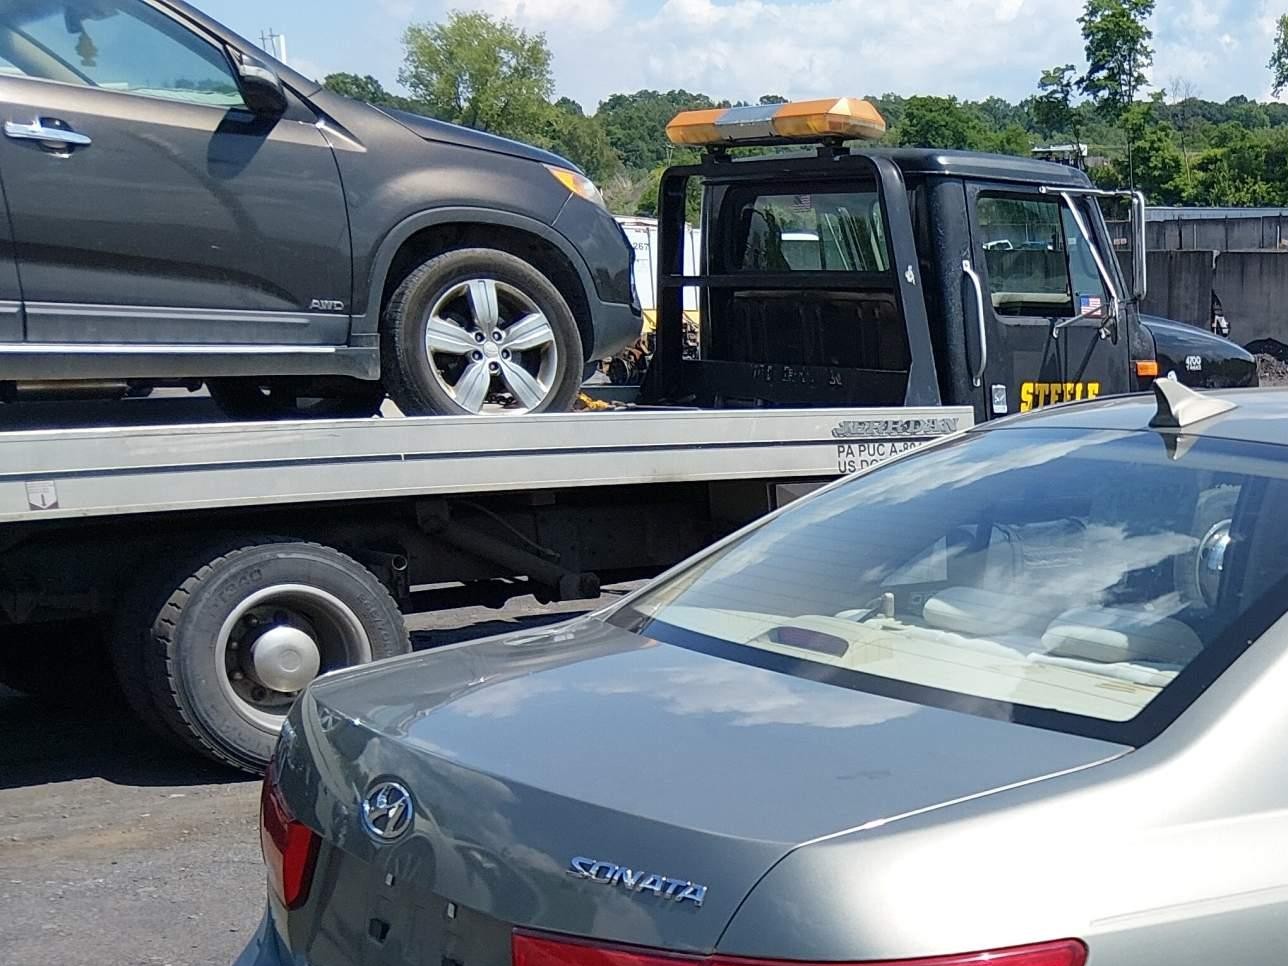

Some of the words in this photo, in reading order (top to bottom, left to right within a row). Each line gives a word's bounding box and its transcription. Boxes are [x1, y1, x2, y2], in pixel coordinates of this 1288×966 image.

[309, 299, 345, 310] AWD
[837, 445, 856, 458] PA
[858, 443, 886, 457] PUC
[838, 459, 857, 474] US
[566, 856, 708, 907] SONATA
